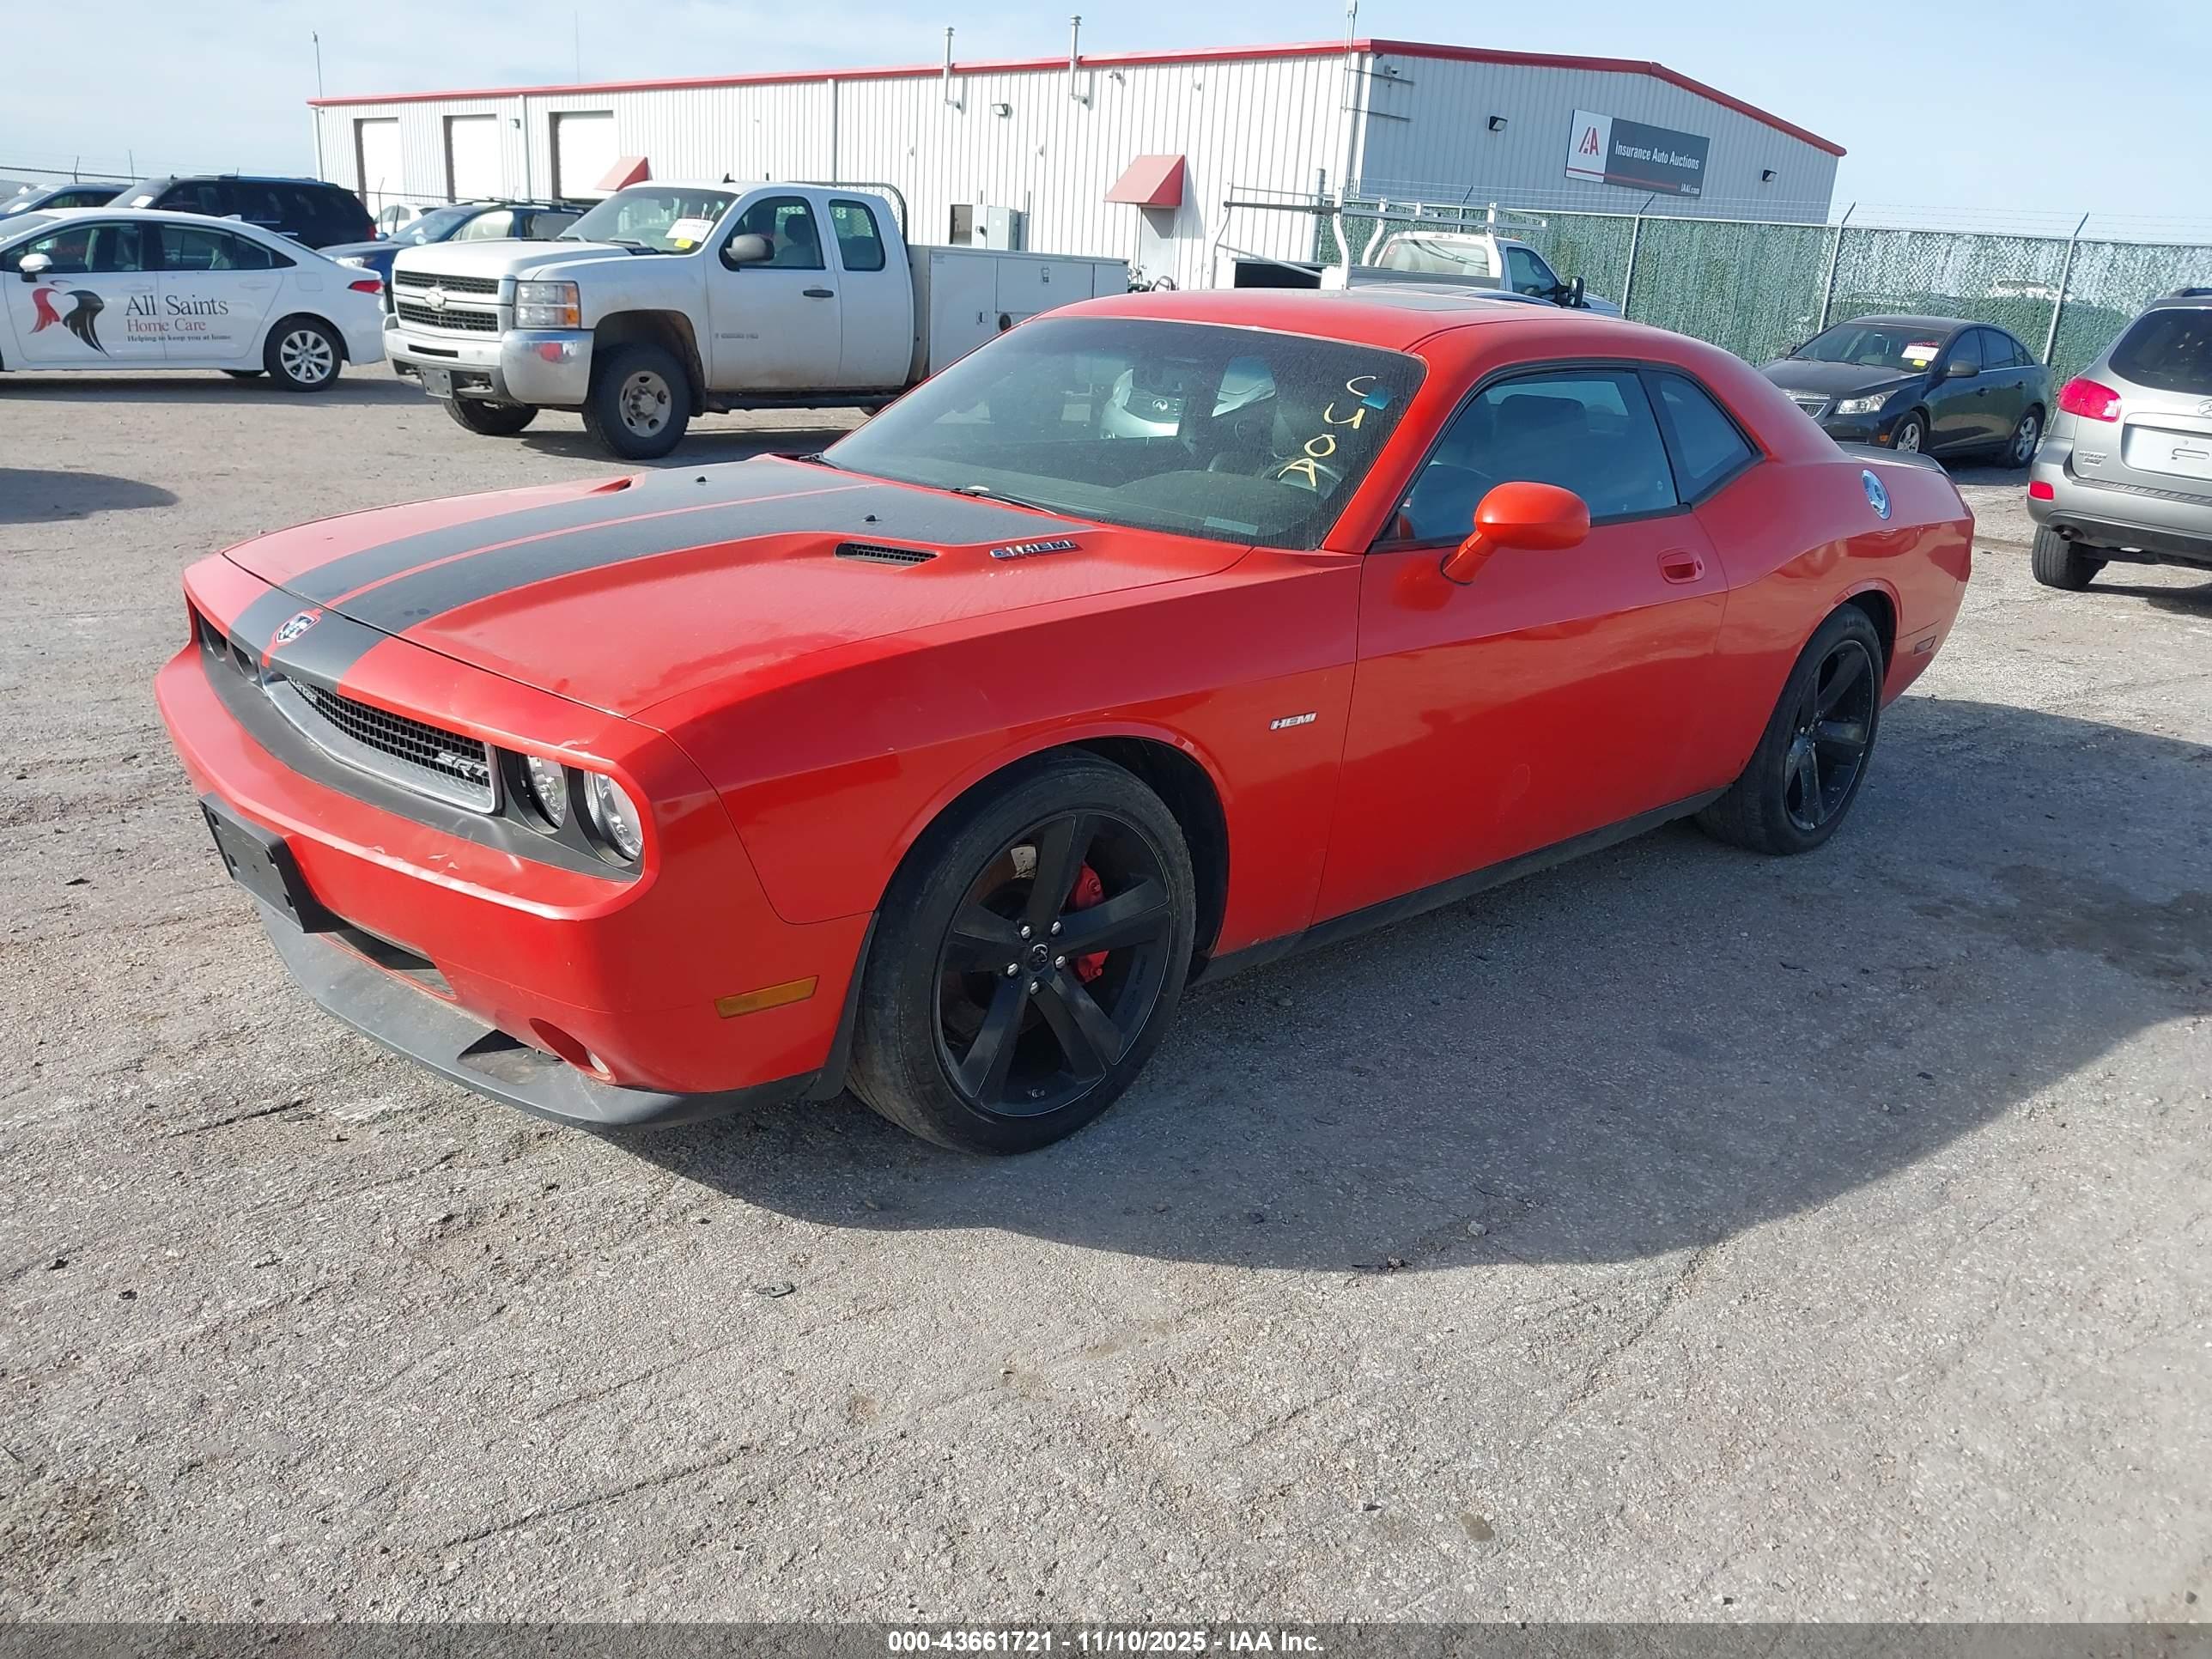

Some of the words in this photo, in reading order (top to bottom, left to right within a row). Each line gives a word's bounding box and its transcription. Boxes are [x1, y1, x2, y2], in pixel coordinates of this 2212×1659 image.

[1615, 140, 1650, 161] Insurance
[1651, 148, 1668, 164] Auto
[1669, 151, 1699, 170] Auctions
[125, 295, 158, 316] All
[165, 294, 228, 316] Saints
[127, 319, 169, 332] Home
[174, 317, 207, 331] Care
[167, 334, 185, 343] keep
[1016, 539, 1076, 556] HEMI
[1270, 712, 1318, 730] HEMI
